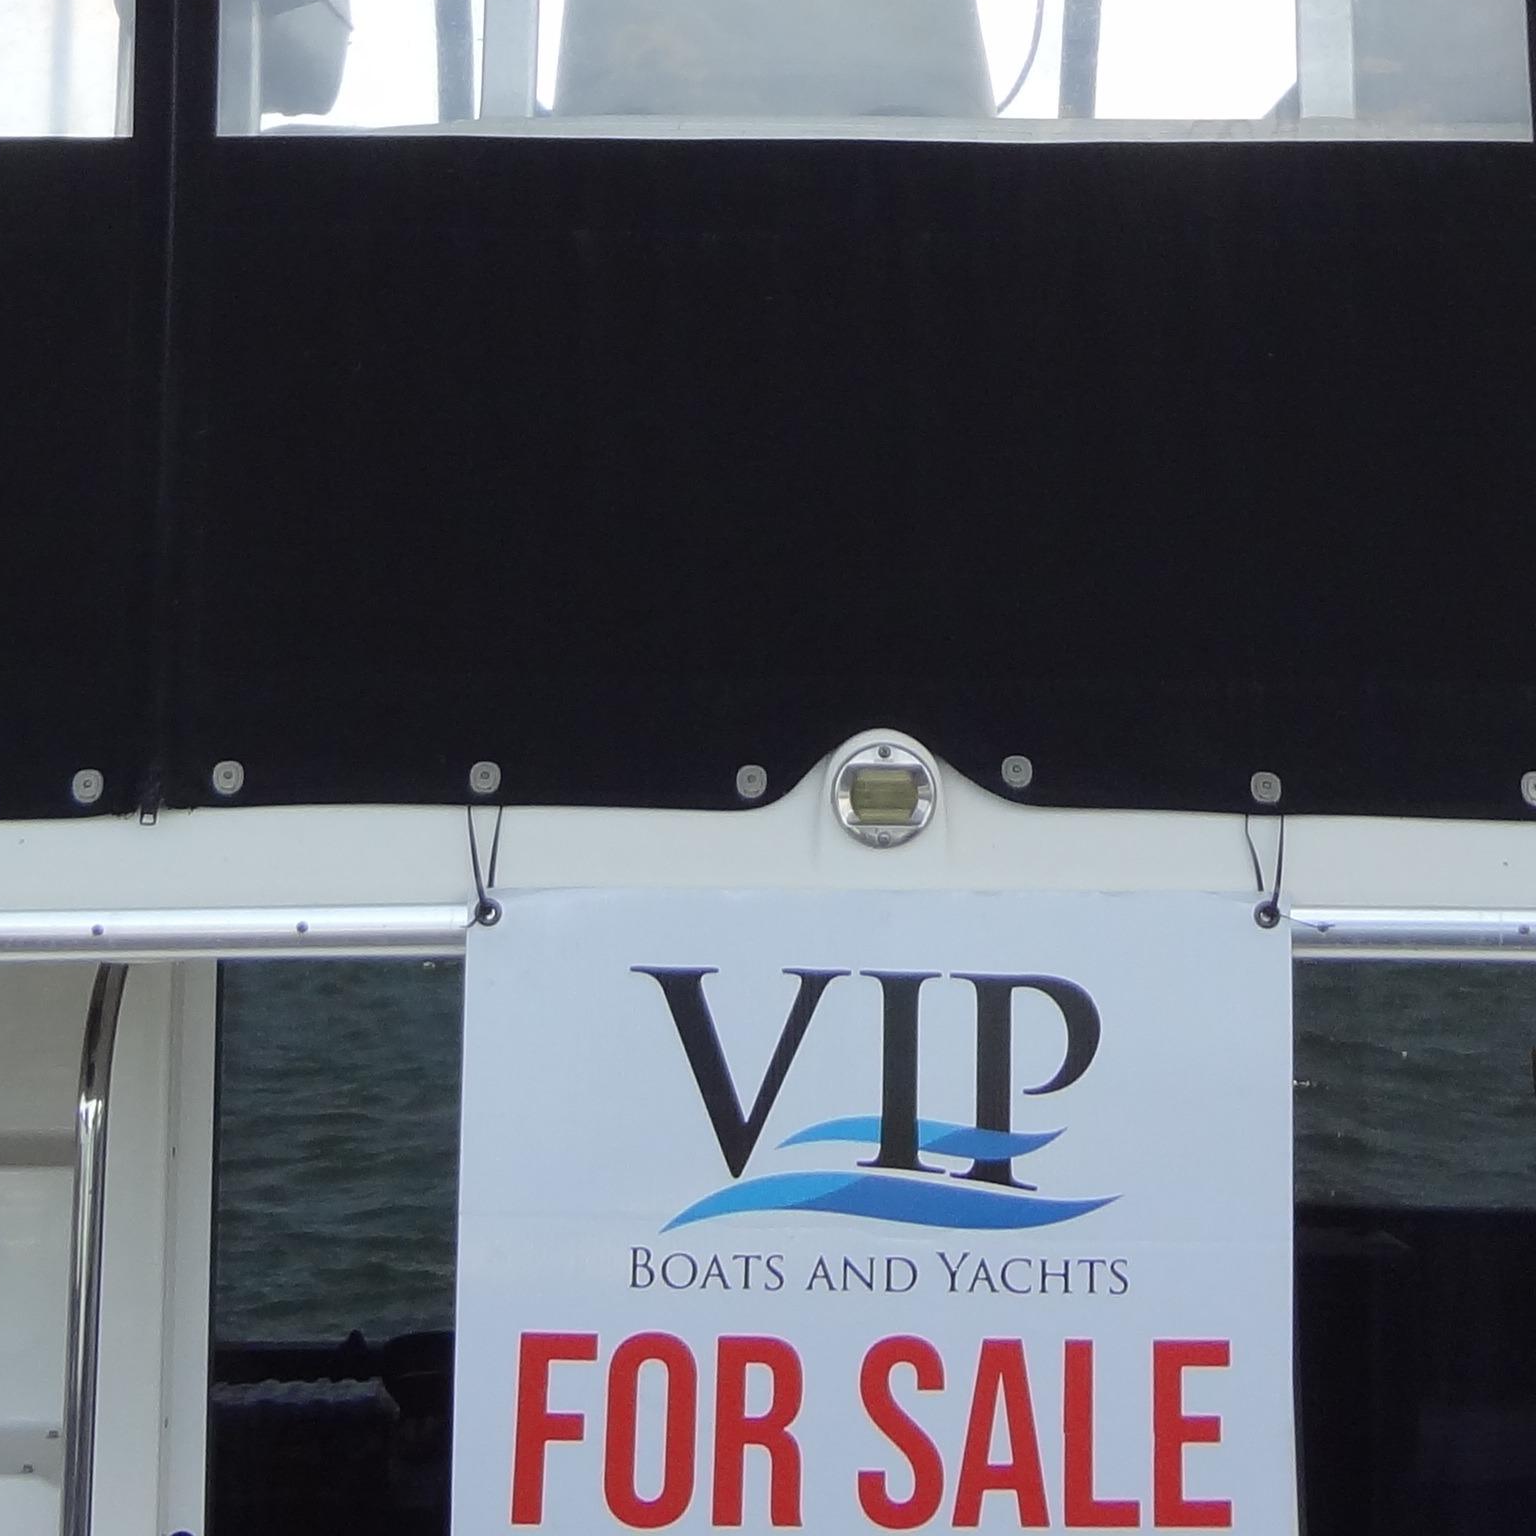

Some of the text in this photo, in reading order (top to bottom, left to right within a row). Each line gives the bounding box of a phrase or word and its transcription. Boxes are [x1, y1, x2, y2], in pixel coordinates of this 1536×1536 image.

[630, 965, 1101, 1191] VIP
[628, 1246, 1130, 1295] BOATS AND YACHTS
[510, 1331, 1233, 1530] FOR SALE
